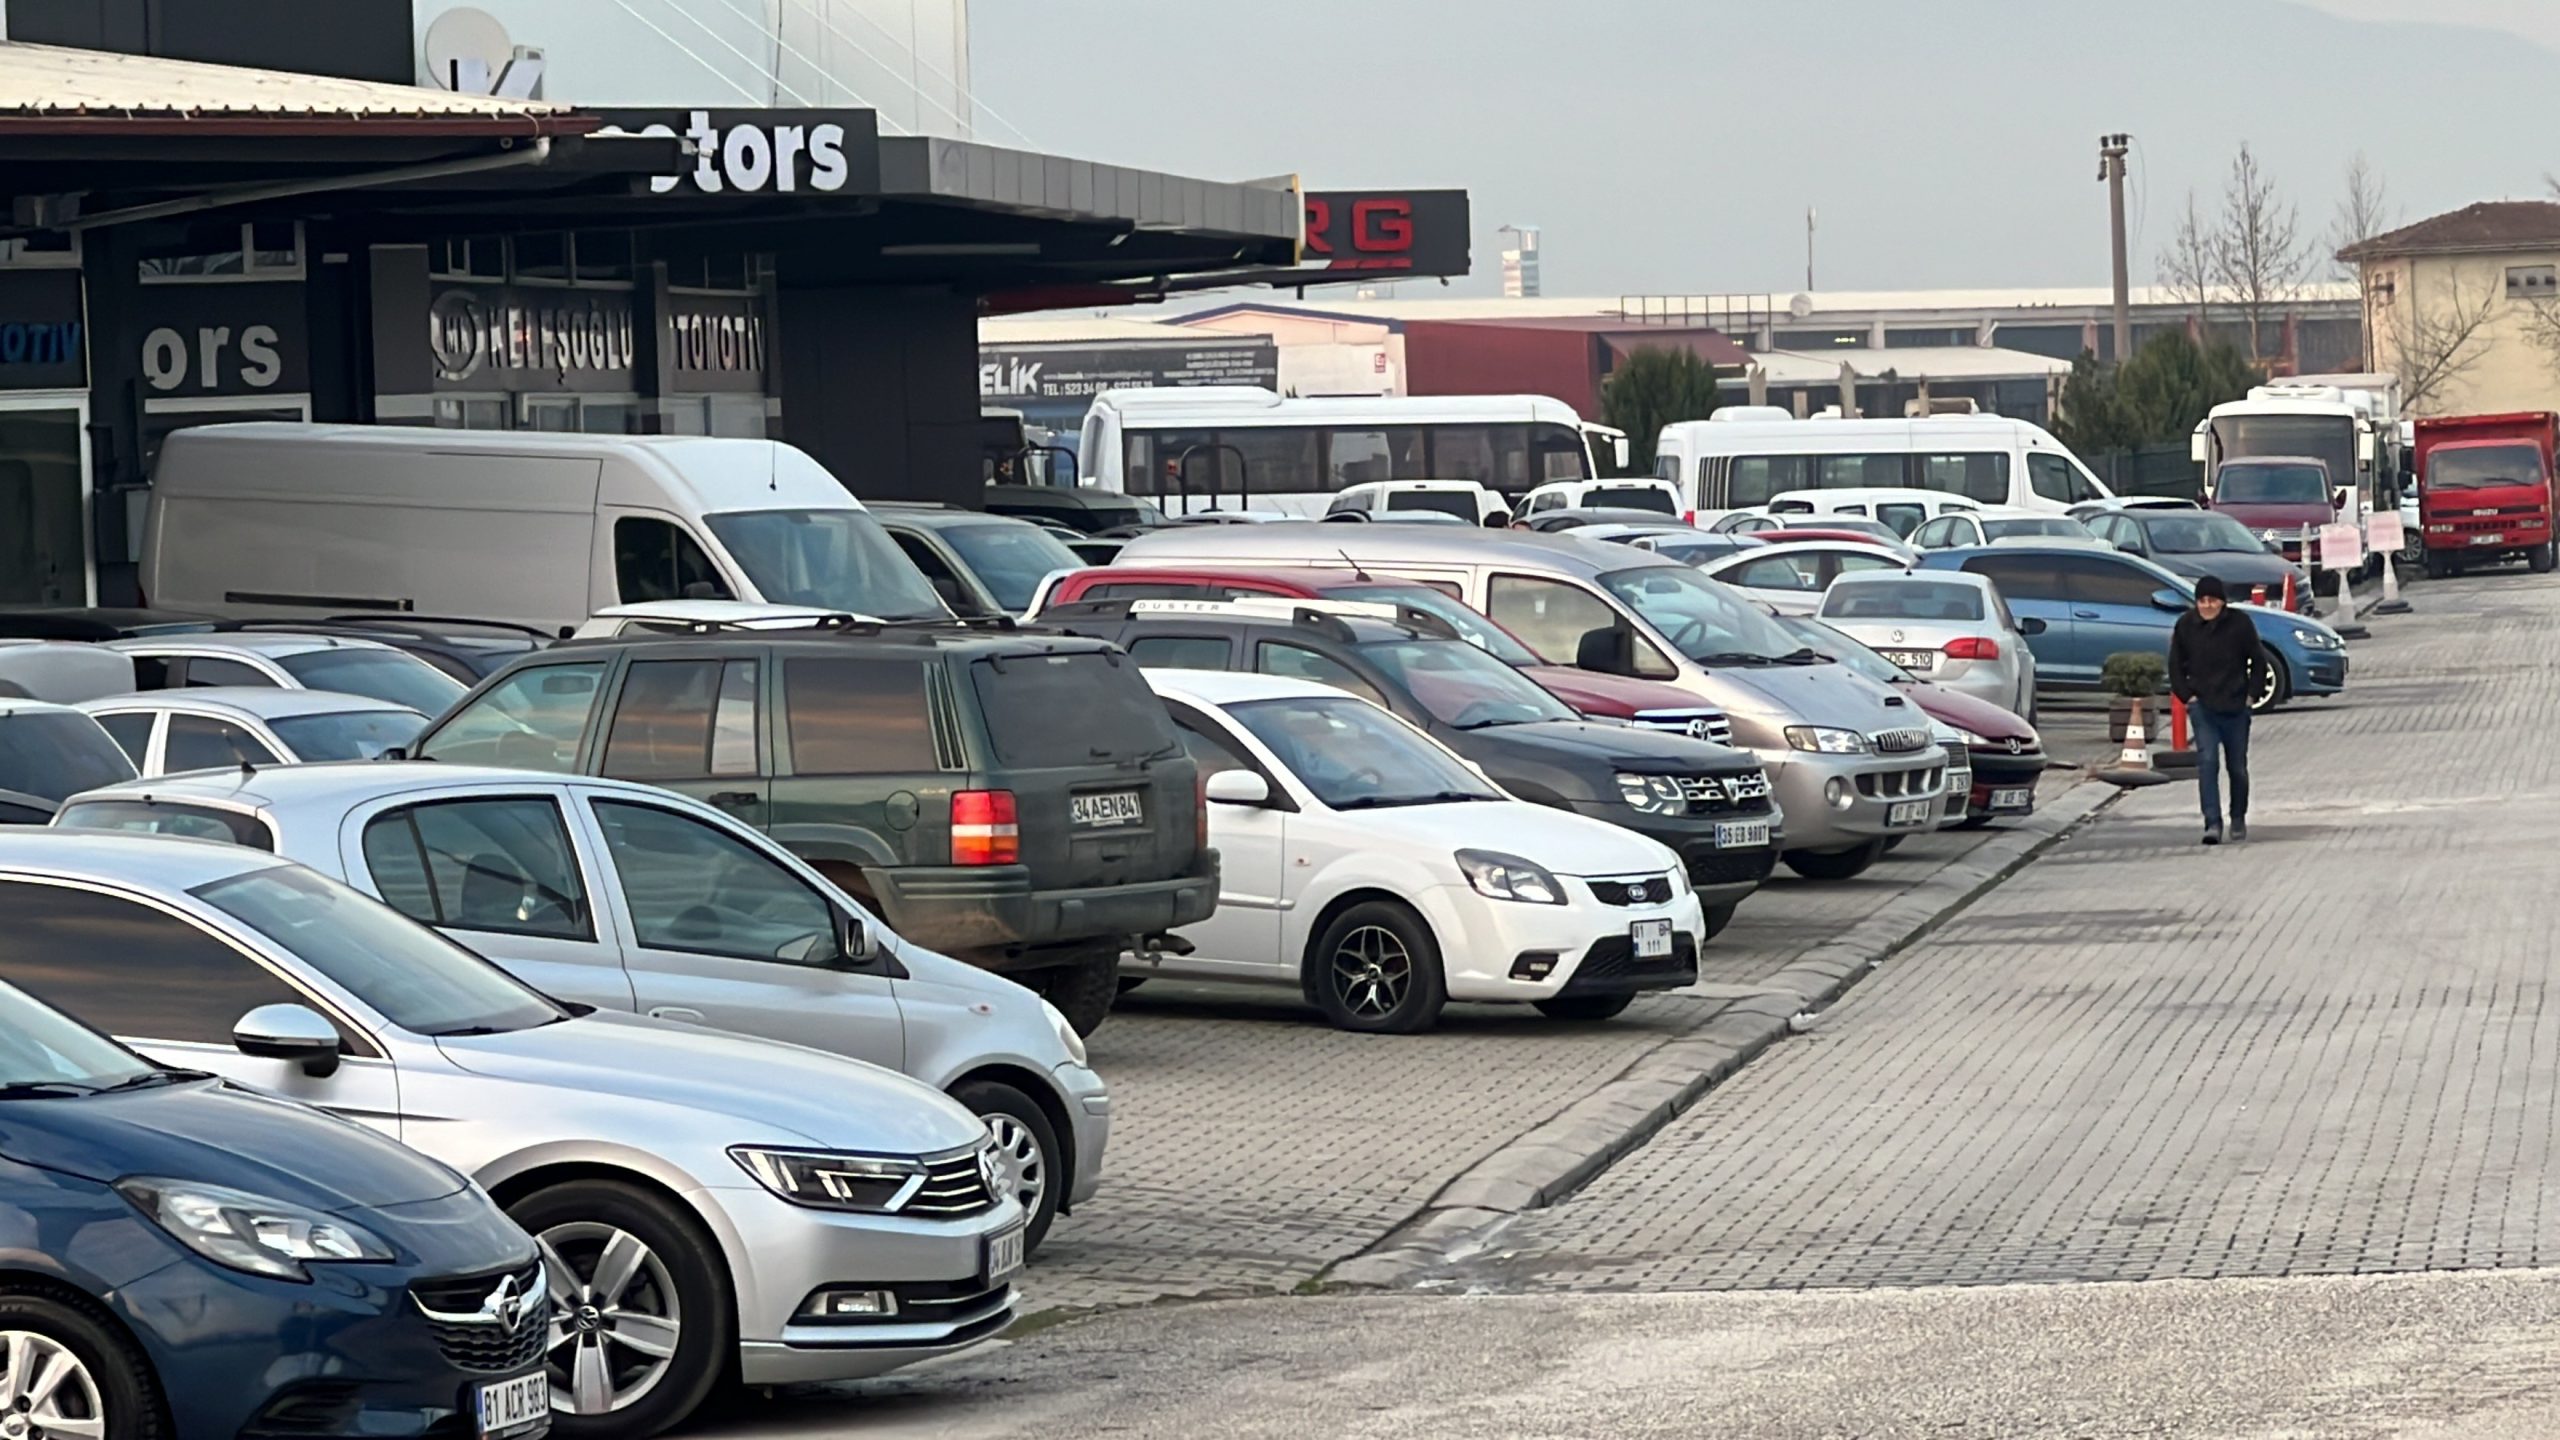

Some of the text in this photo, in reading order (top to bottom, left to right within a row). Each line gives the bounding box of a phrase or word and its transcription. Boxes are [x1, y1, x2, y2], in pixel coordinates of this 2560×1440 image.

[1138, 602, 1220, 611] DUSTER
[484, 1389, 499, 1427] 81
[505, 1382, 525, 1422] ACR
